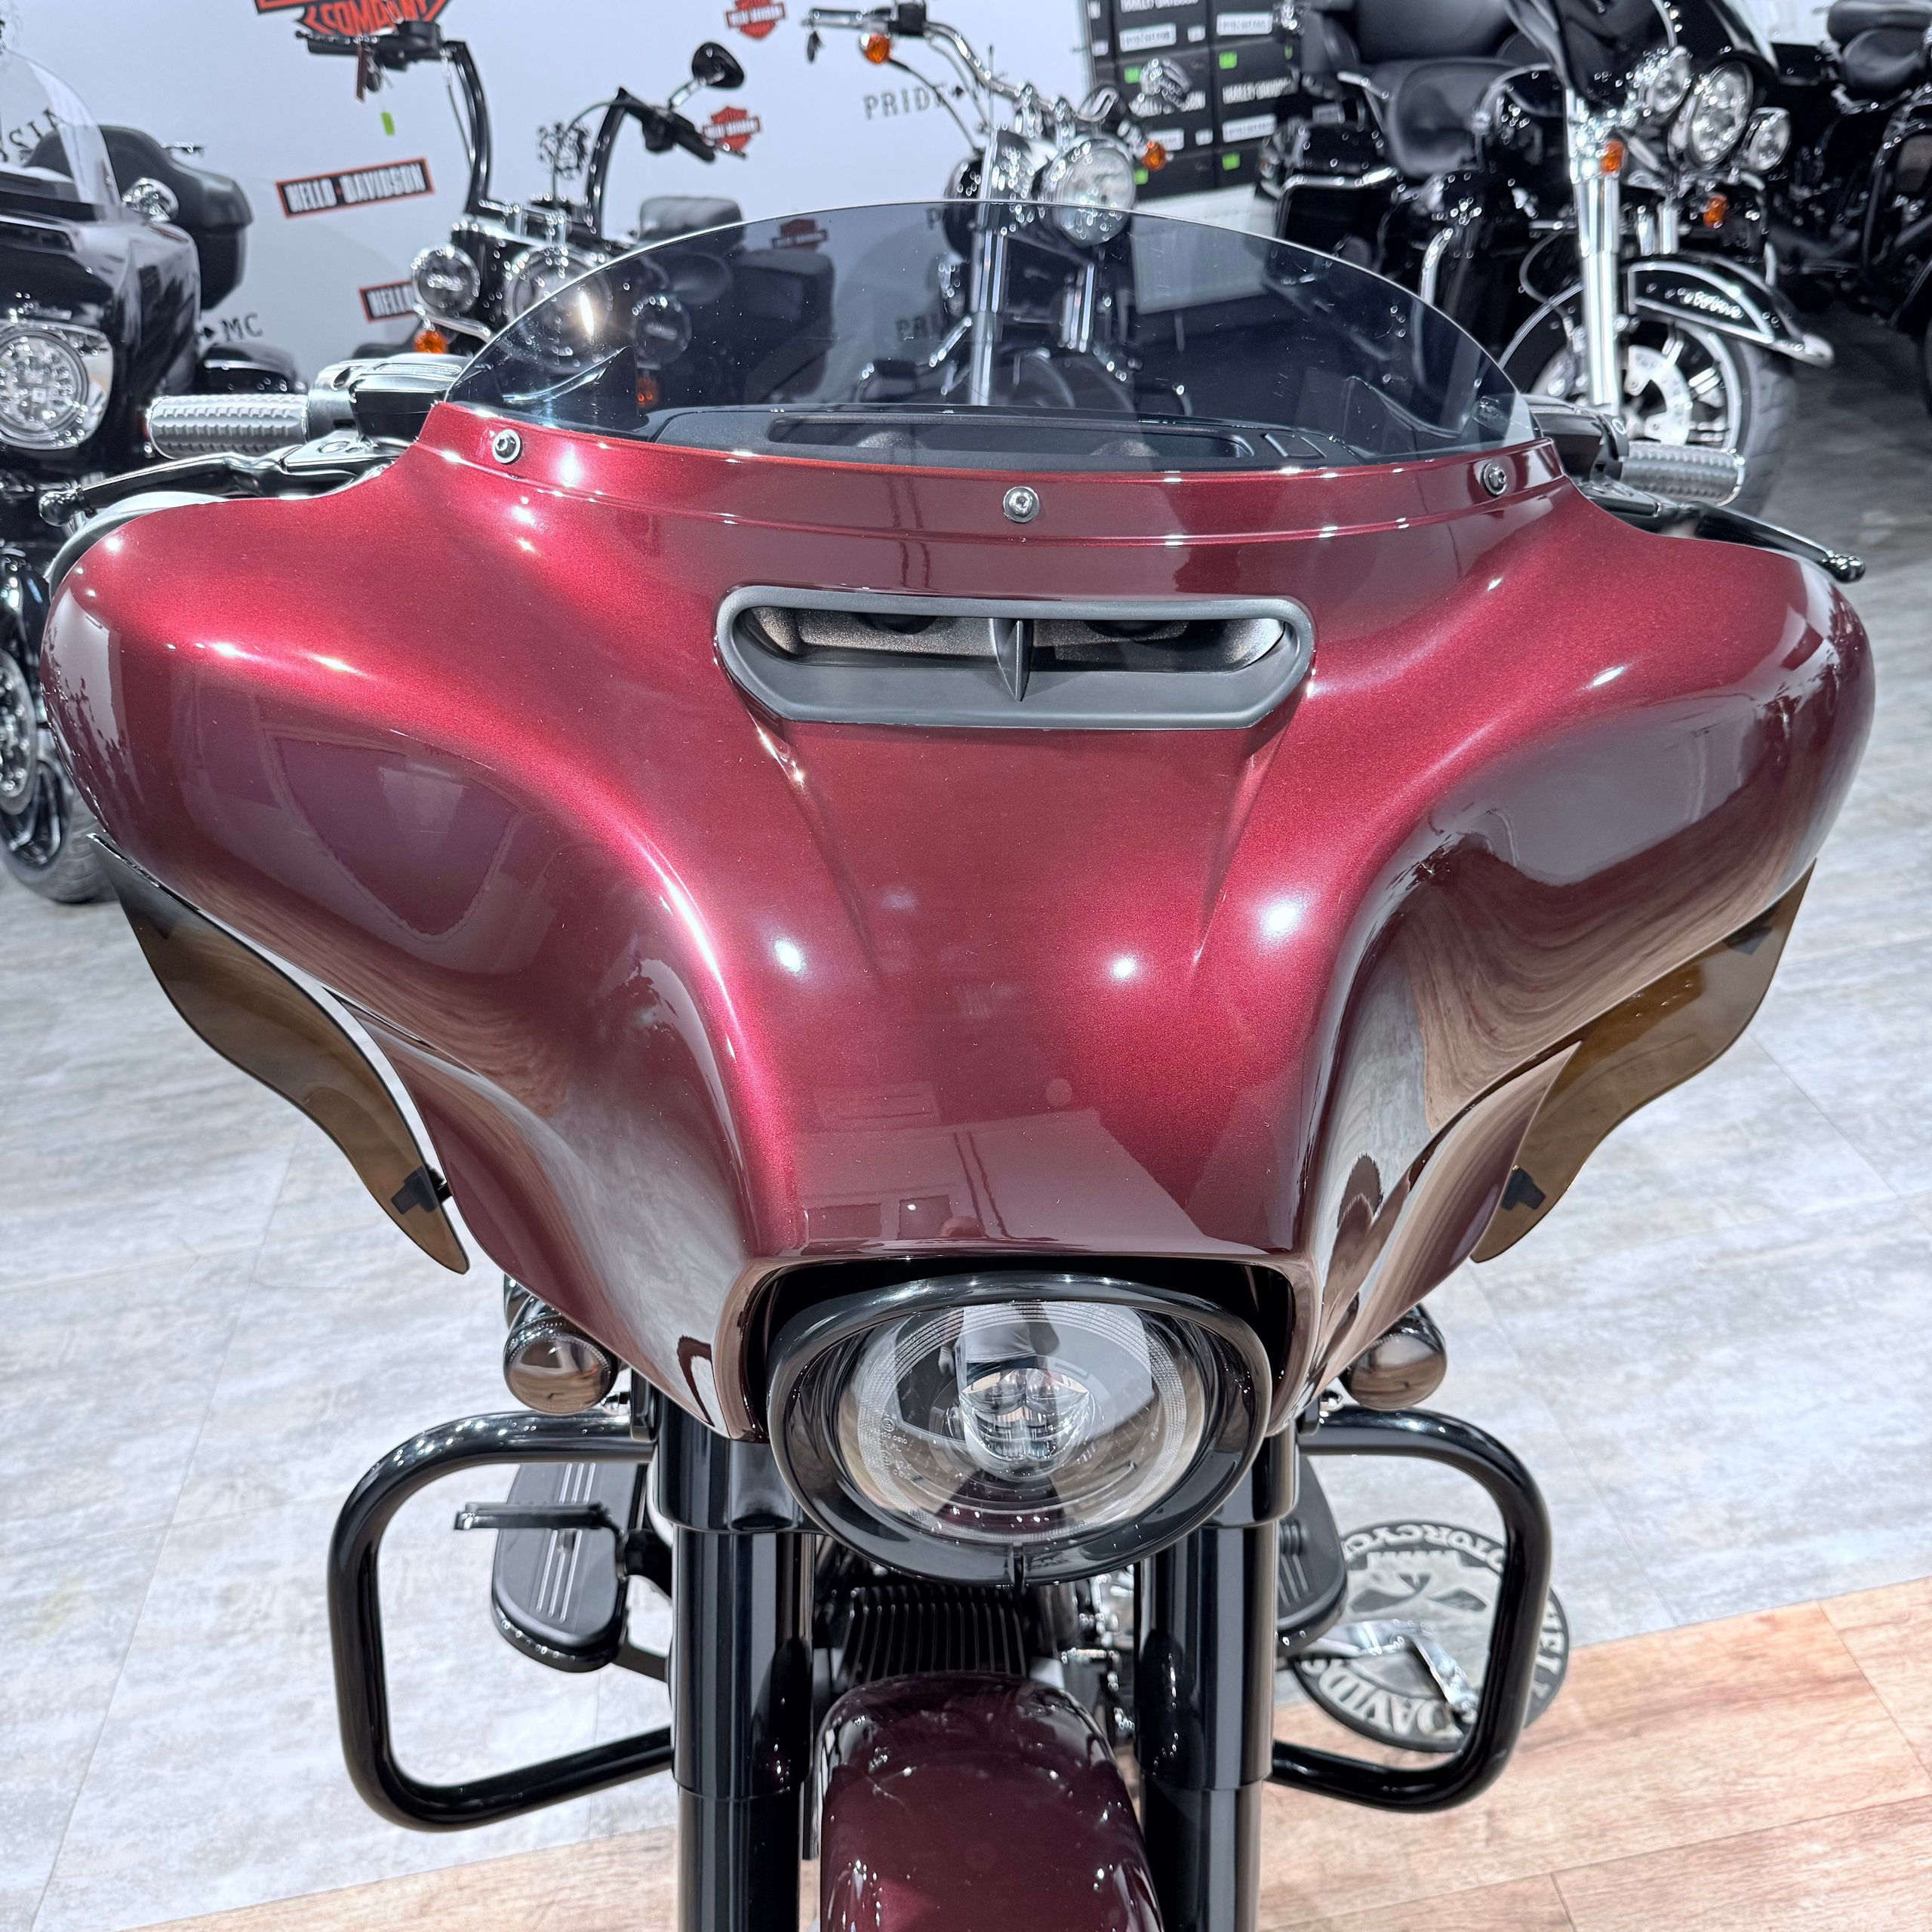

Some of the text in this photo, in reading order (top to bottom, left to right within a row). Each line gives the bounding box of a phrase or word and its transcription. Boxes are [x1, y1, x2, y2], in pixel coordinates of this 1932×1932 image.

[284, 163, 427, 213] HELLO DAVIDSON
[220, 312, 263, 342] MC
